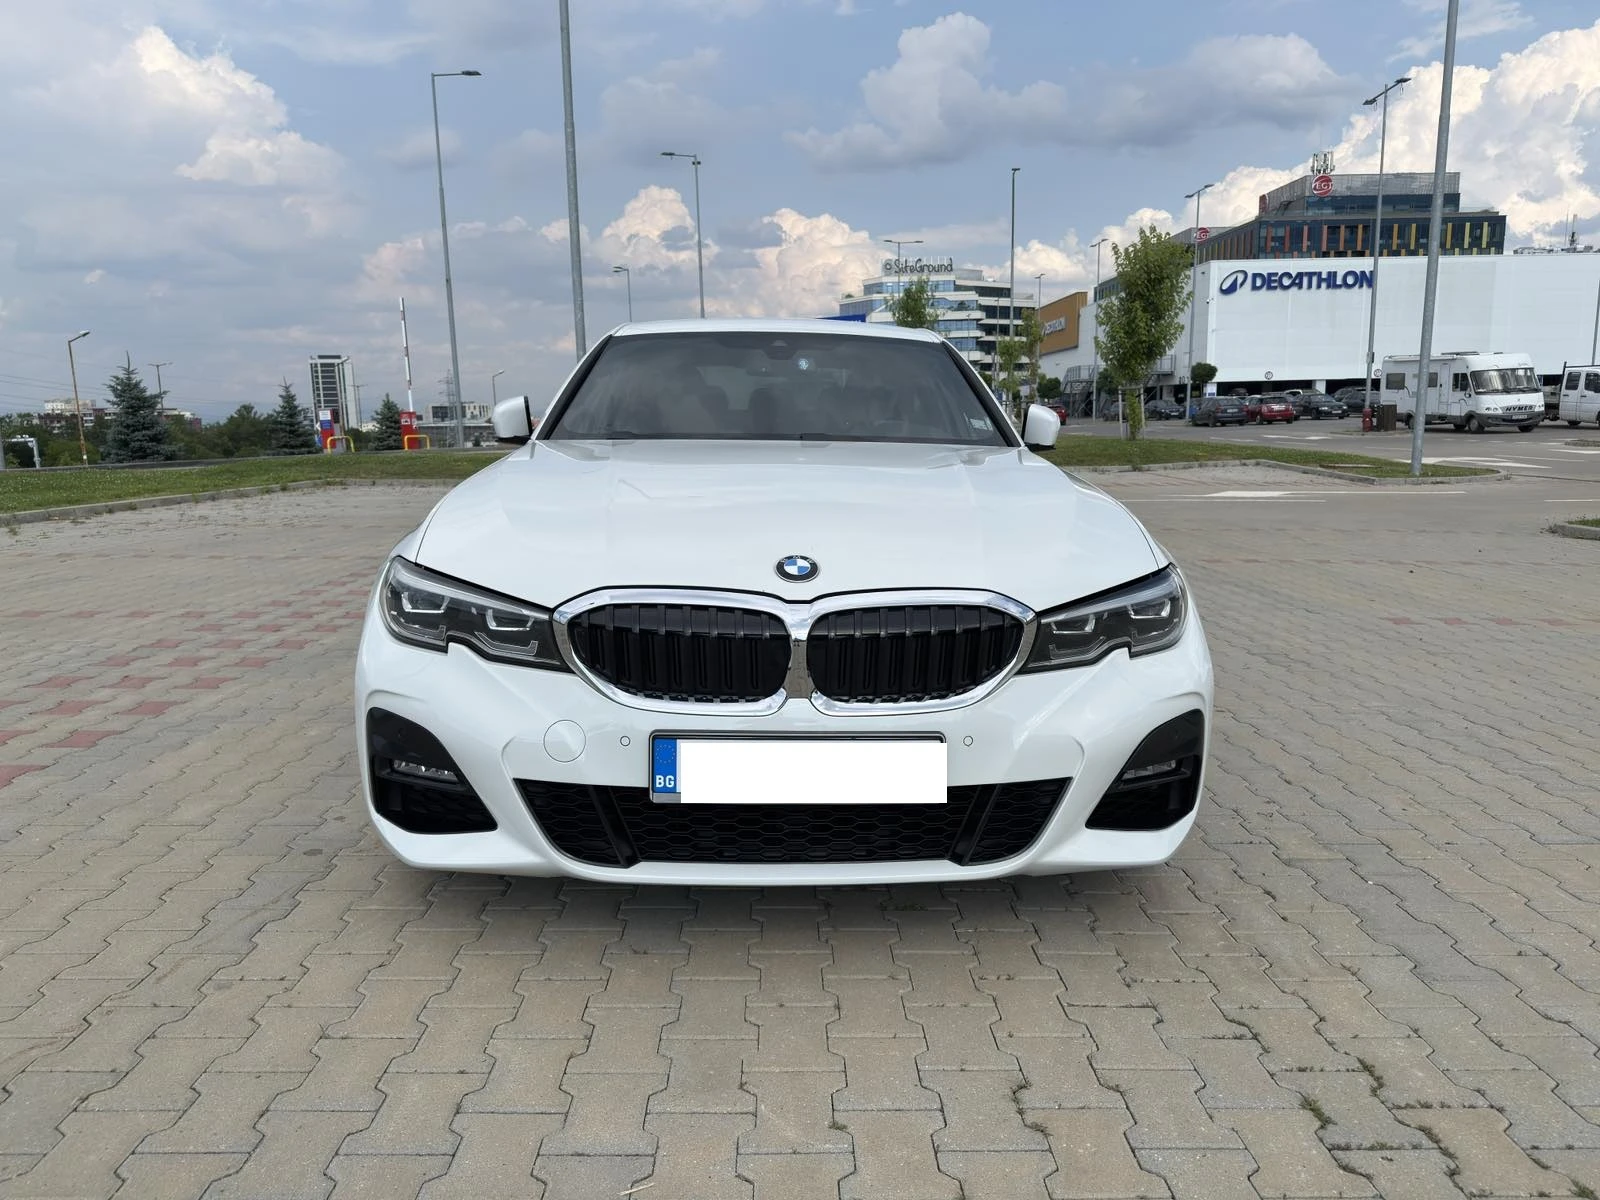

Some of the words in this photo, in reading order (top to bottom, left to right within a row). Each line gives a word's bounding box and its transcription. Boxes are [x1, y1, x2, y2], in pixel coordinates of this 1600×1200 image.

[894, 257, 953, 274] SiteGround
[1250, 270, 1373, 291] DECATHLON
[655, 774, 675, 788] BG
